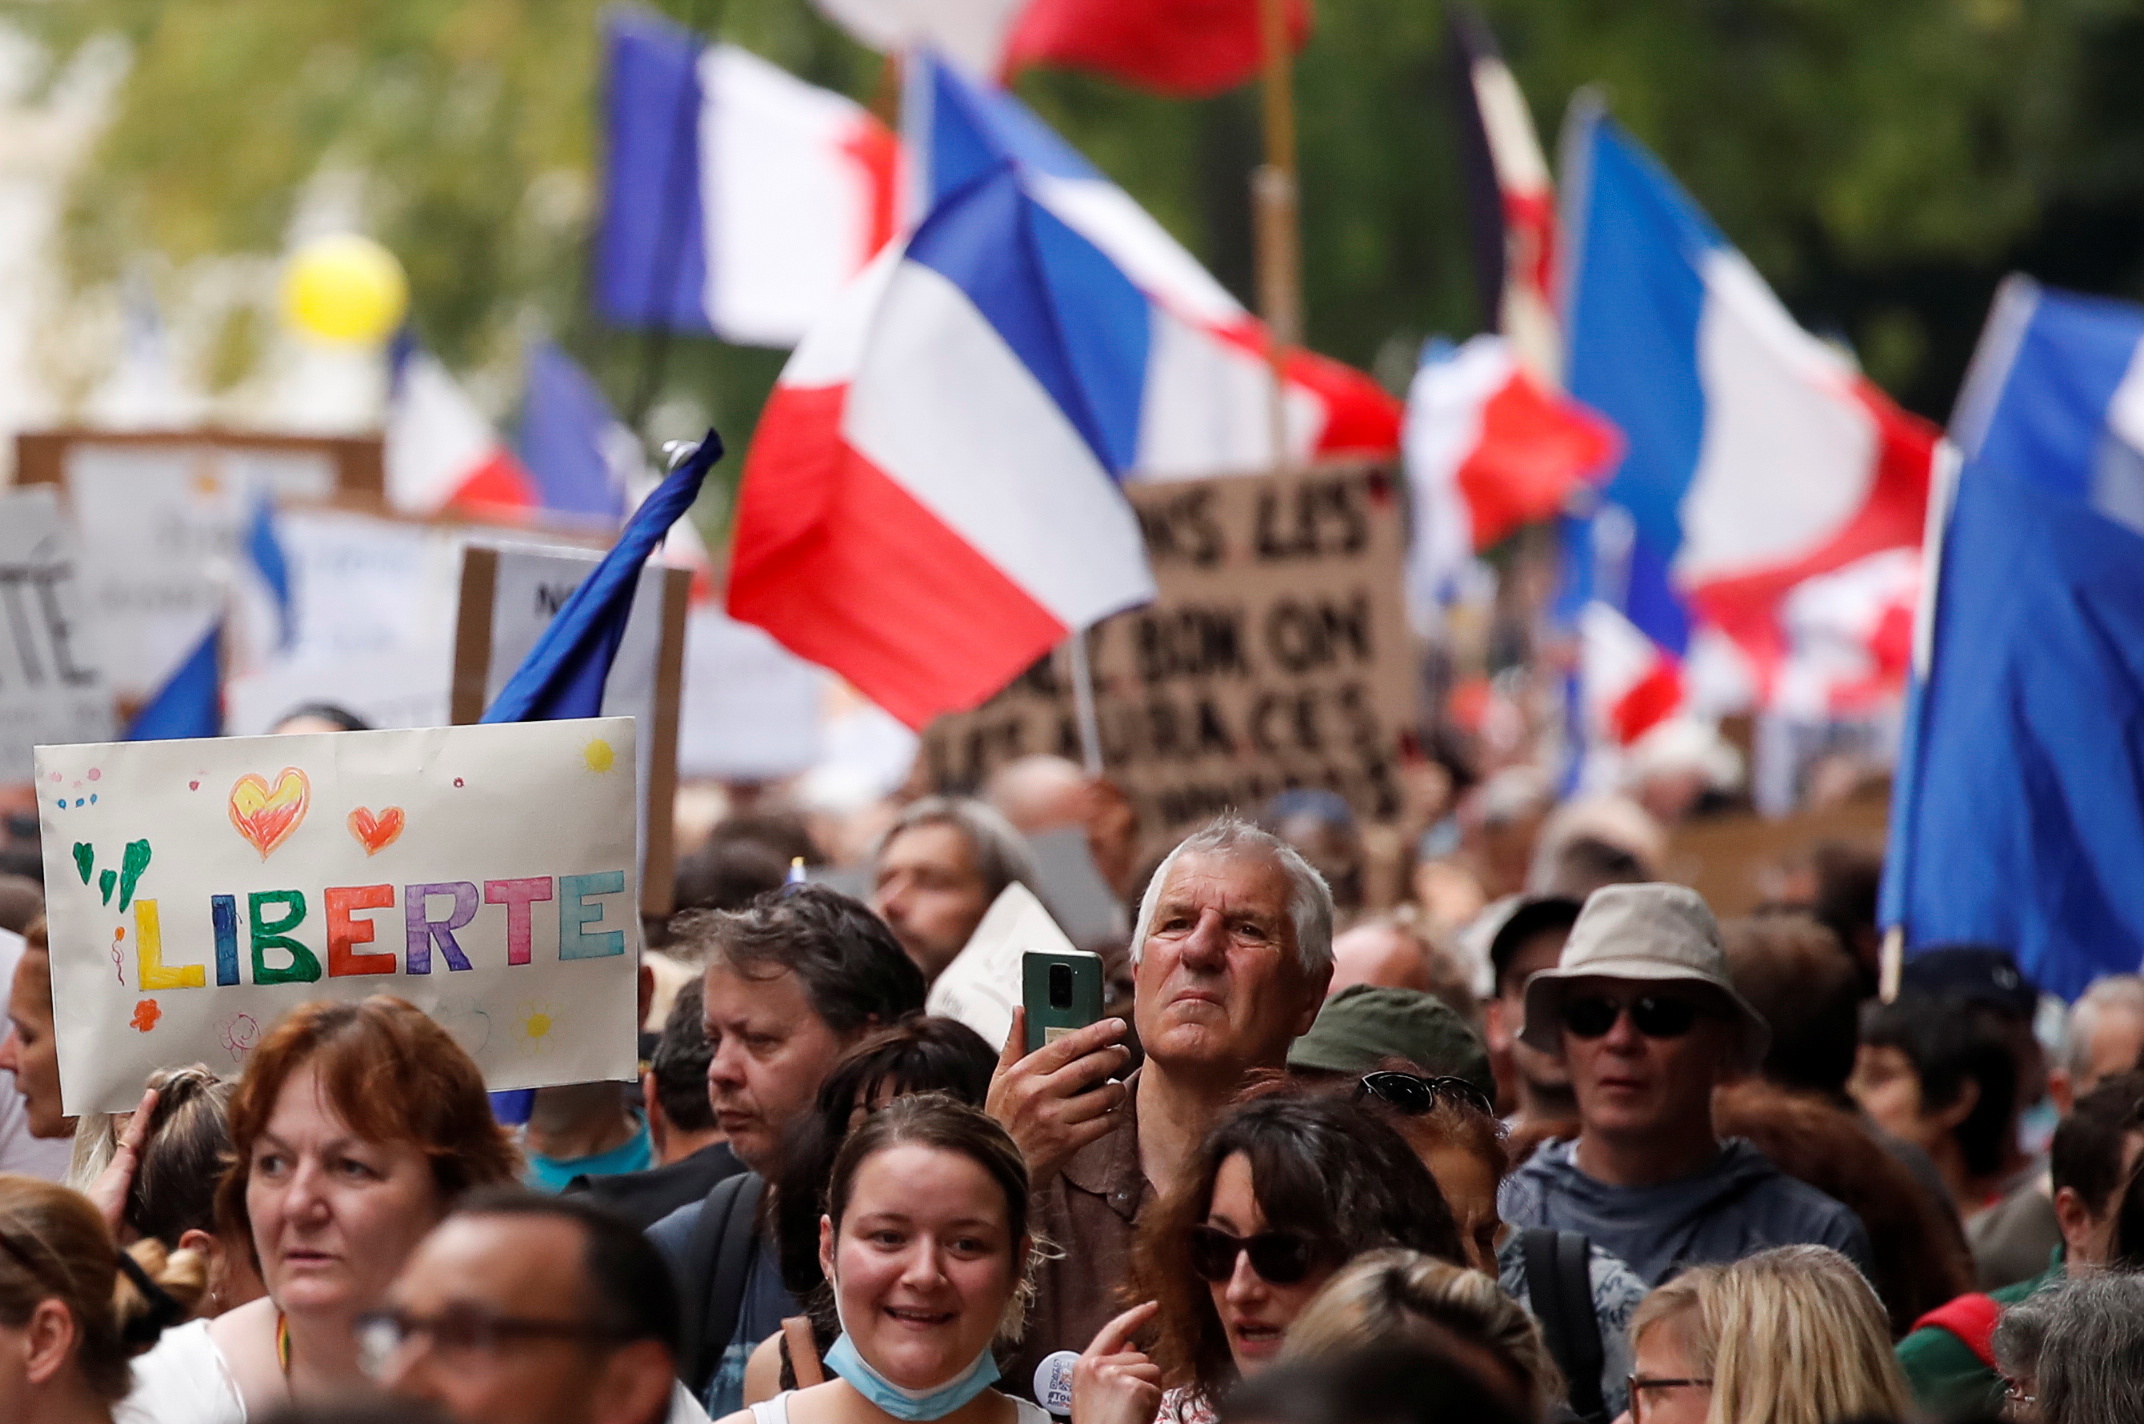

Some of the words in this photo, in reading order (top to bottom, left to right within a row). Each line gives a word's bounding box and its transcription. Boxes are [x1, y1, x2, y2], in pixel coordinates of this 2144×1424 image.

[1256, 480, 1369, 561] LES
[1264, 589, 1374, 674] ON
[133, 870, 625, 991] LIBERTE
